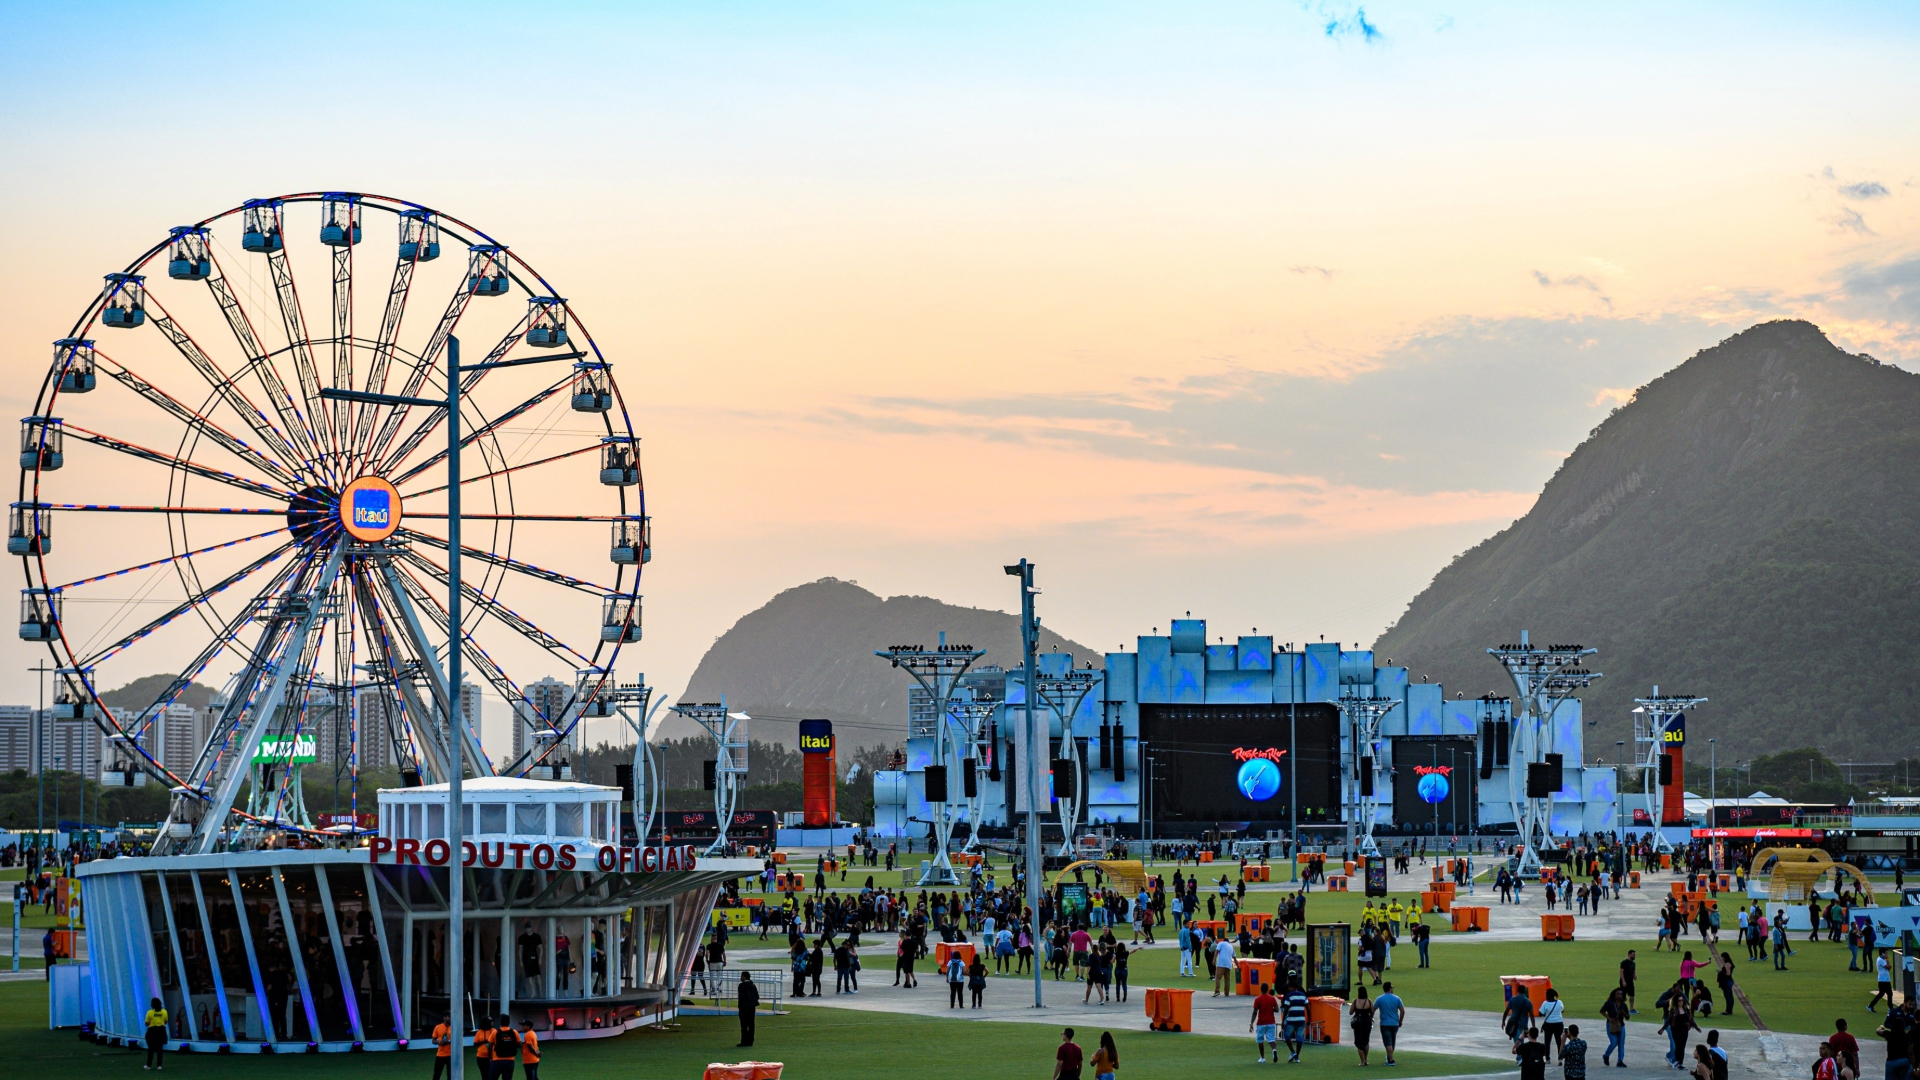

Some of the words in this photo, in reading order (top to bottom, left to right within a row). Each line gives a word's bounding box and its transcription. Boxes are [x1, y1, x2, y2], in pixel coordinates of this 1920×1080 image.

[356, 508, 388, 523] Itaú
[801, 734, 830, 748] Itaú
[1653, 729, 1684, 742] aú
[1231, 747, 1259, 762] Rock
[1265, 747, 1287, 763] Rio
[683, 814, 704, 824] Bob's
[734, 812, 755, 824] Bob's
[369, 837, 577, 871] PRODUTOS
[597, 844, 697, 873] OFICIAIS
